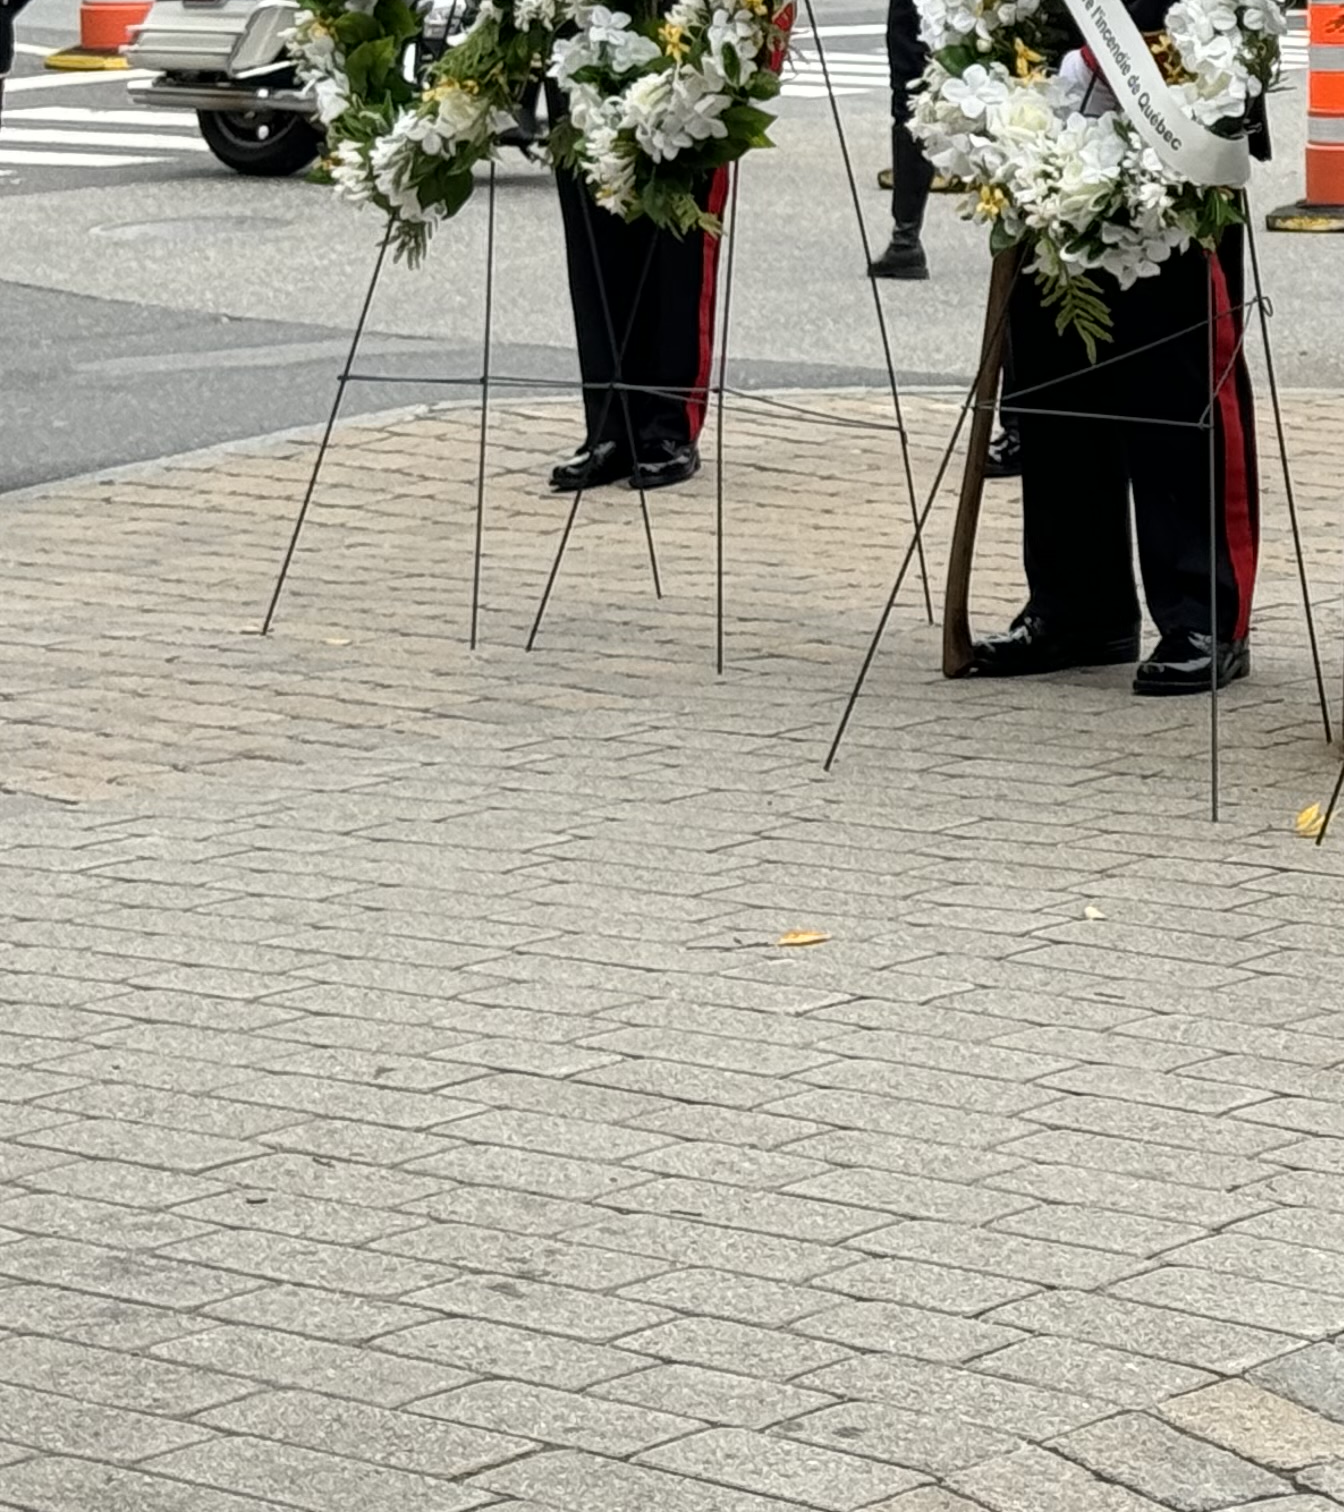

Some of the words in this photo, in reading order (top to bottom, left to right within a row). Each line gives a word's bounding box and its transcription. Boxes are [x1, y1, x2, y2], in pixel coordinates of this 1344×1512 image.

[1090, 5, 1132, 77] l'incendie
[1127, 74, 1141, 96] de
[1137, 91, 1183, 151] Québec
